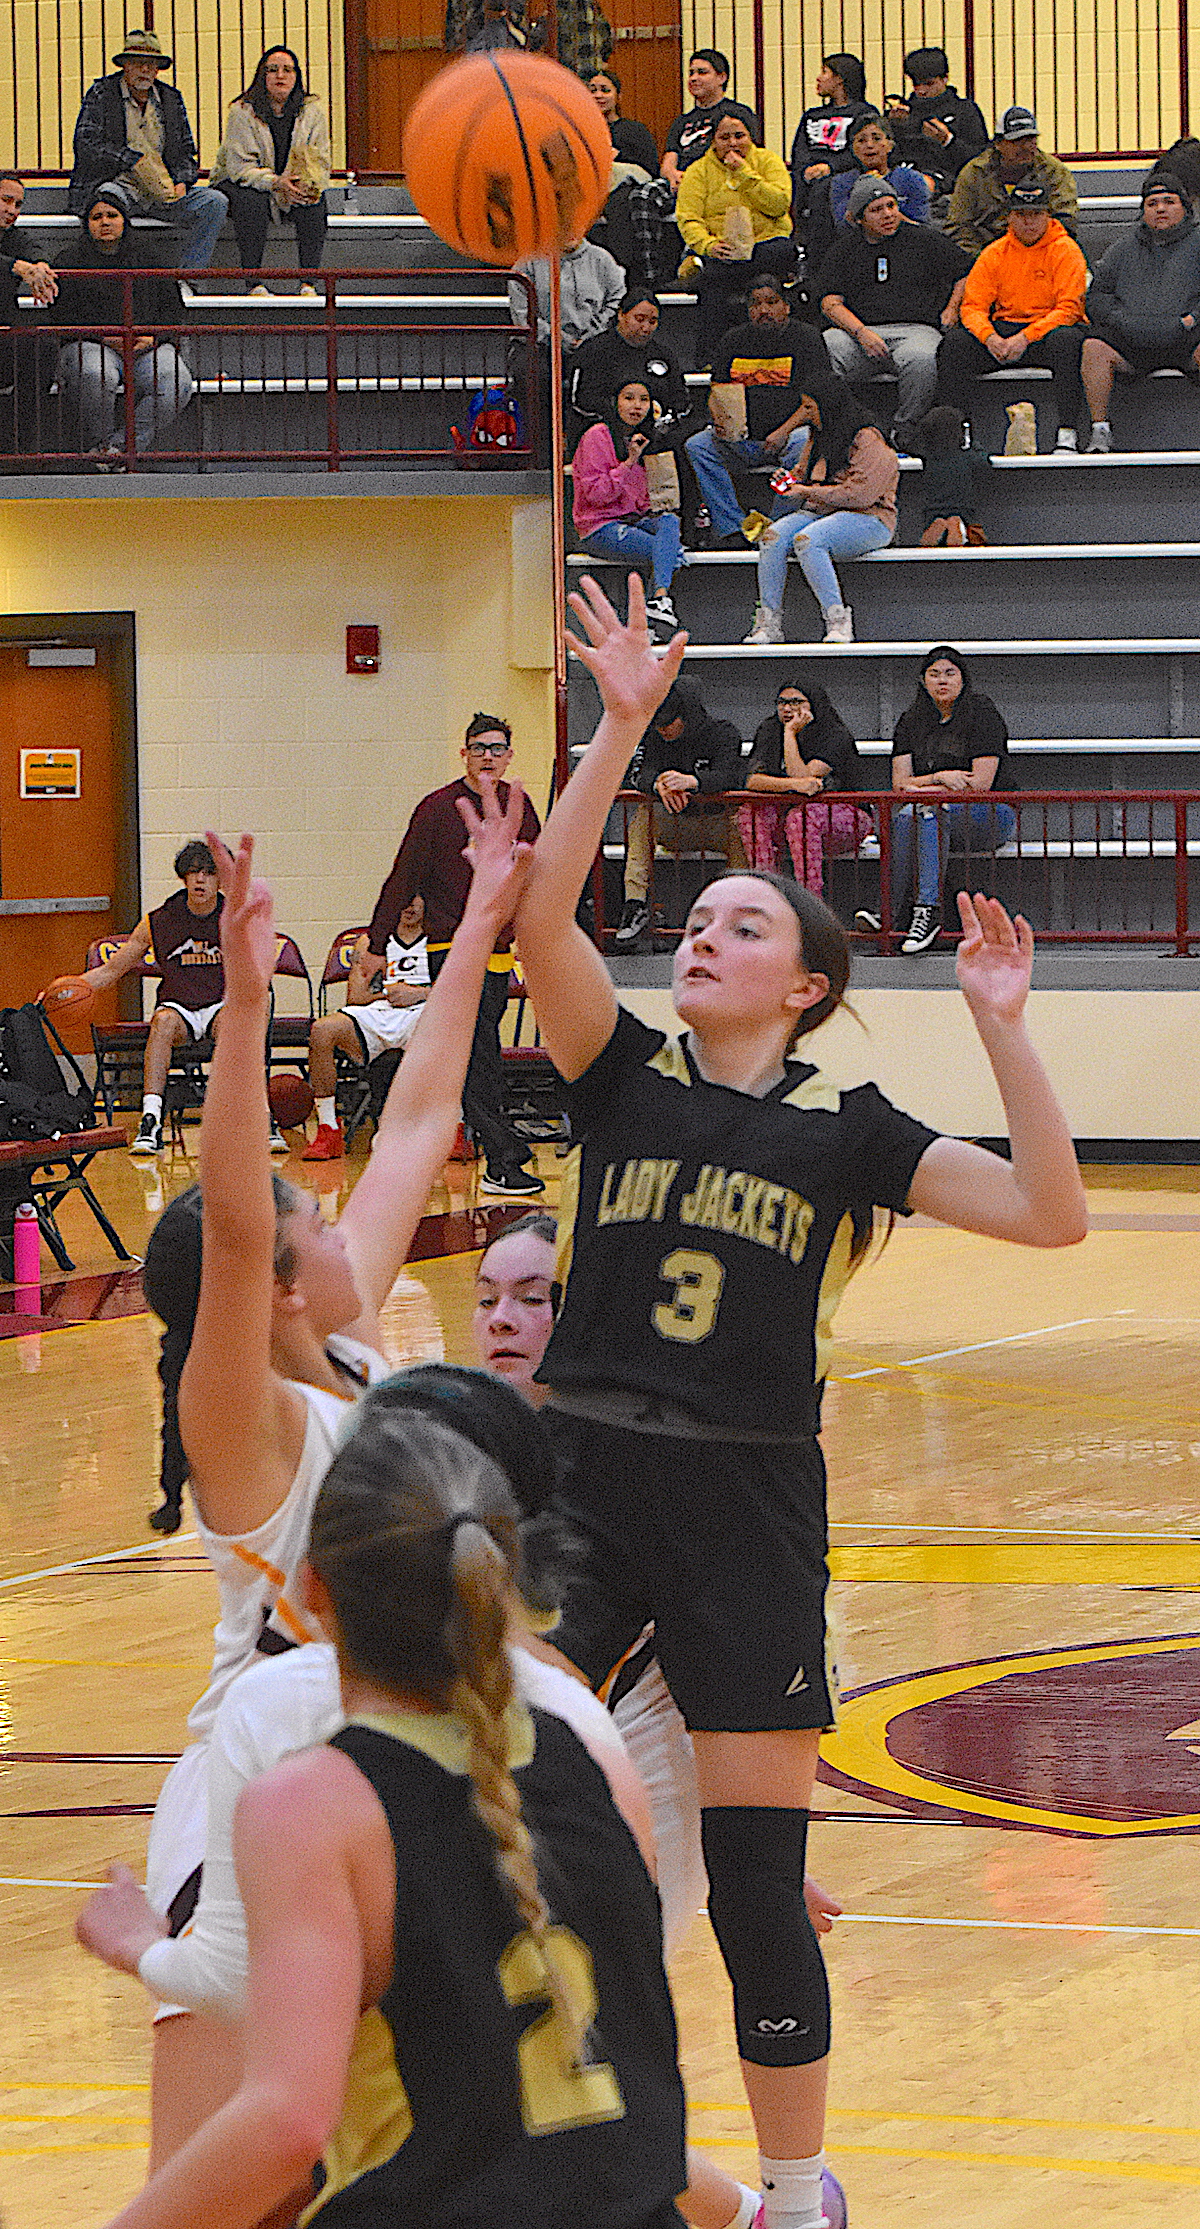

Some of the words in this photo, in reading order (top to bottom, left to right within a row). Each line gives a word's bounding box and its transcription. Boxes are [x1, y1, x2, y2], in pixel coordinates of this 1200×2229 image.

[597, 1158, 682, 1226] LADY
[679, 1164, 815, 1264] JACKETS
[652, 1248, 725, 1343] 3
[497, 1925, 626, 2137] 2
